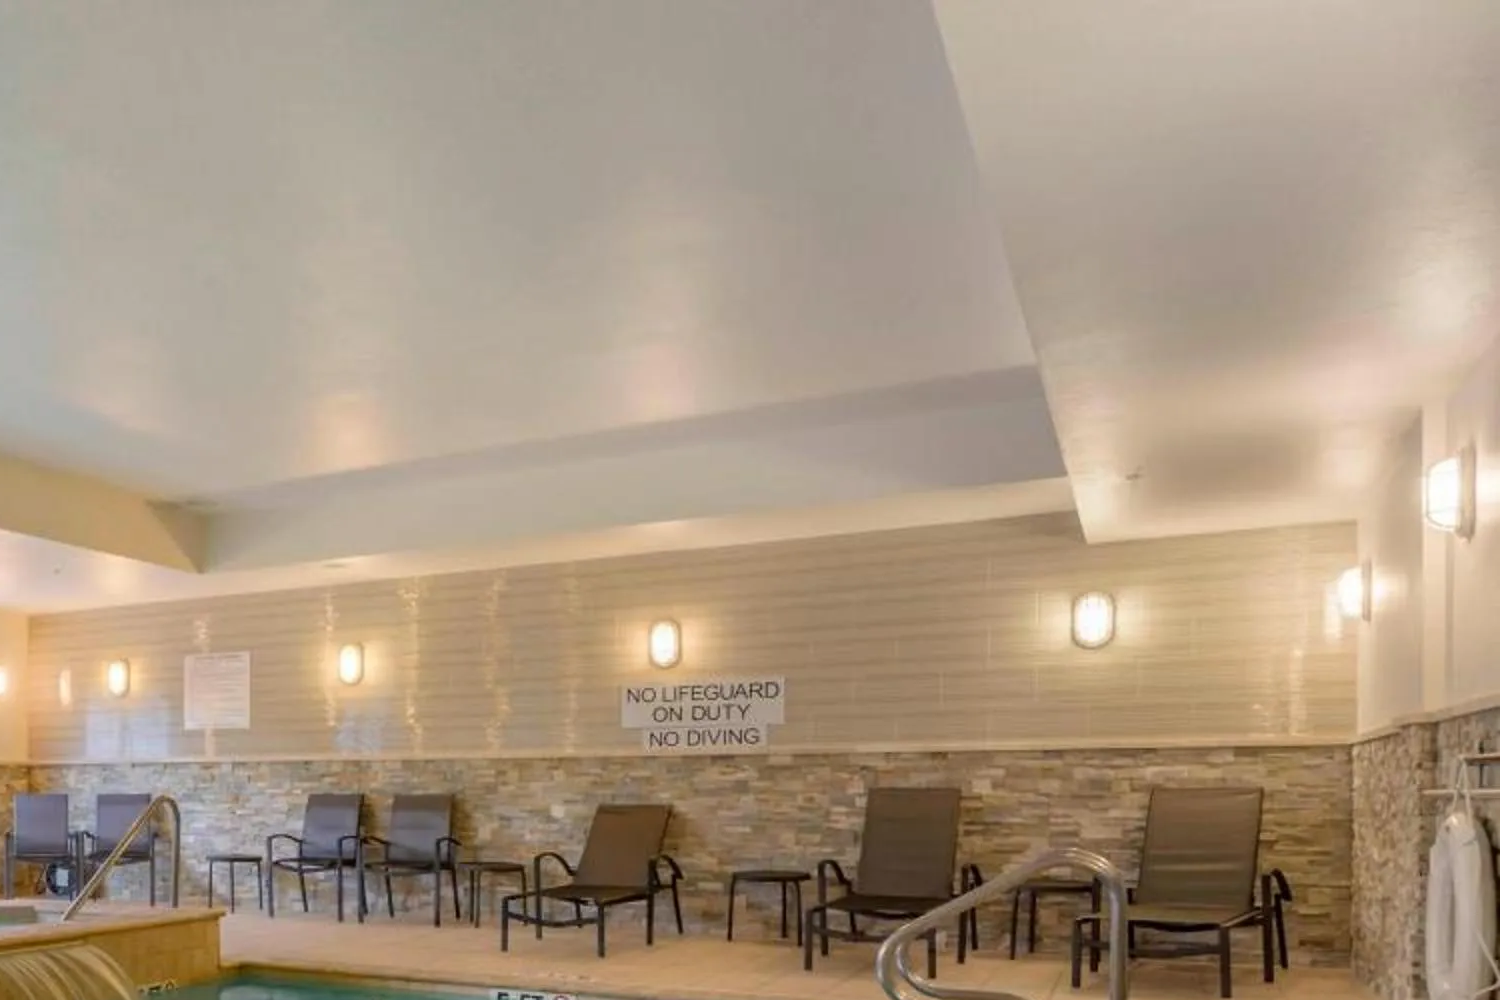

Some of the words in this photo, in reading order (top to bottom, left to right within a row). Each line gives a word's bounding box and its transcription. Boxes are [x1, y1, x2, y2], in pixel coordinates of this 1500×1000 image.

[627, 687, 657, 704] NO
[662, 681, 780, 703] LIFEGUARD
[652, 706, 683, 723] ON
[691, 703, 751, 721] DUTY
[649, 730, 680, 747] NO
[687, 728, 760, 747] DIVING
